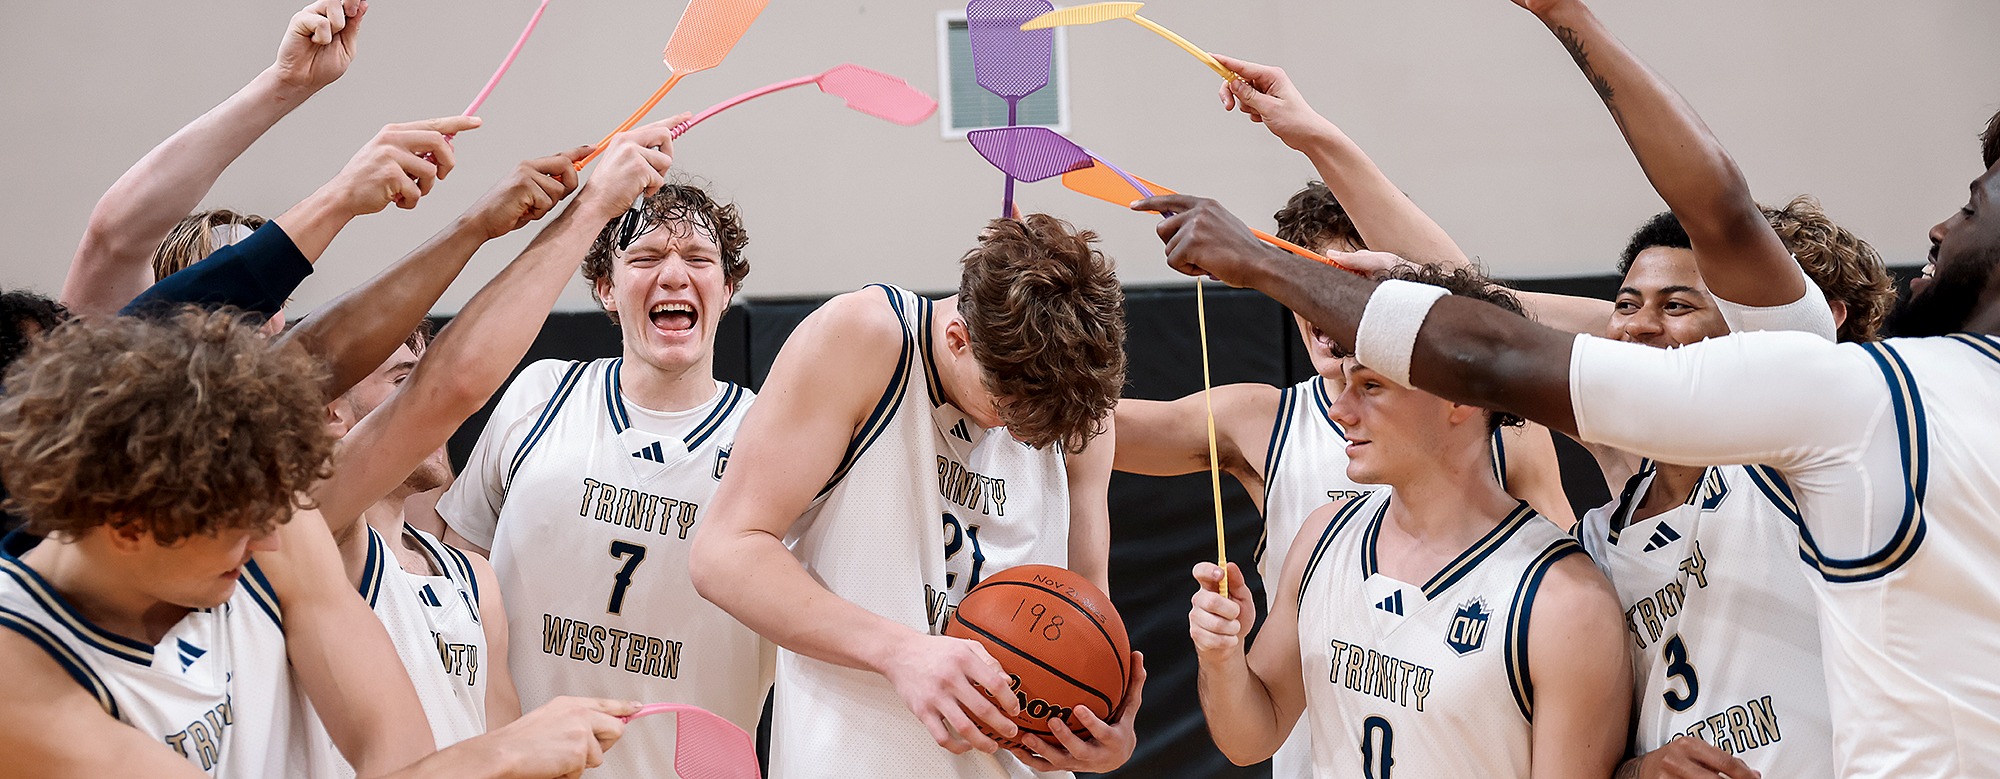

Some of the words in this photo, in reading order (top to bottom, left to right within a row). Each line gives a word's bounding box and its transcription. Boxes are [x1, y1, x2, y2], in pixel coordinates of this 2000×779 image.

[579, 478, 698, 539] TRINITY
[936, 455, 1006, 516] RINITY
[608, 539, 647, 616] 7
[1033, 574, 1064, 589] Nov
[542, 613, 682, 679] WESTERN
[1011, 598, 1064, 641] 198
[1329, 639, 1434, 712] TRINITY
[1661, 630, 1700, 714] 3
